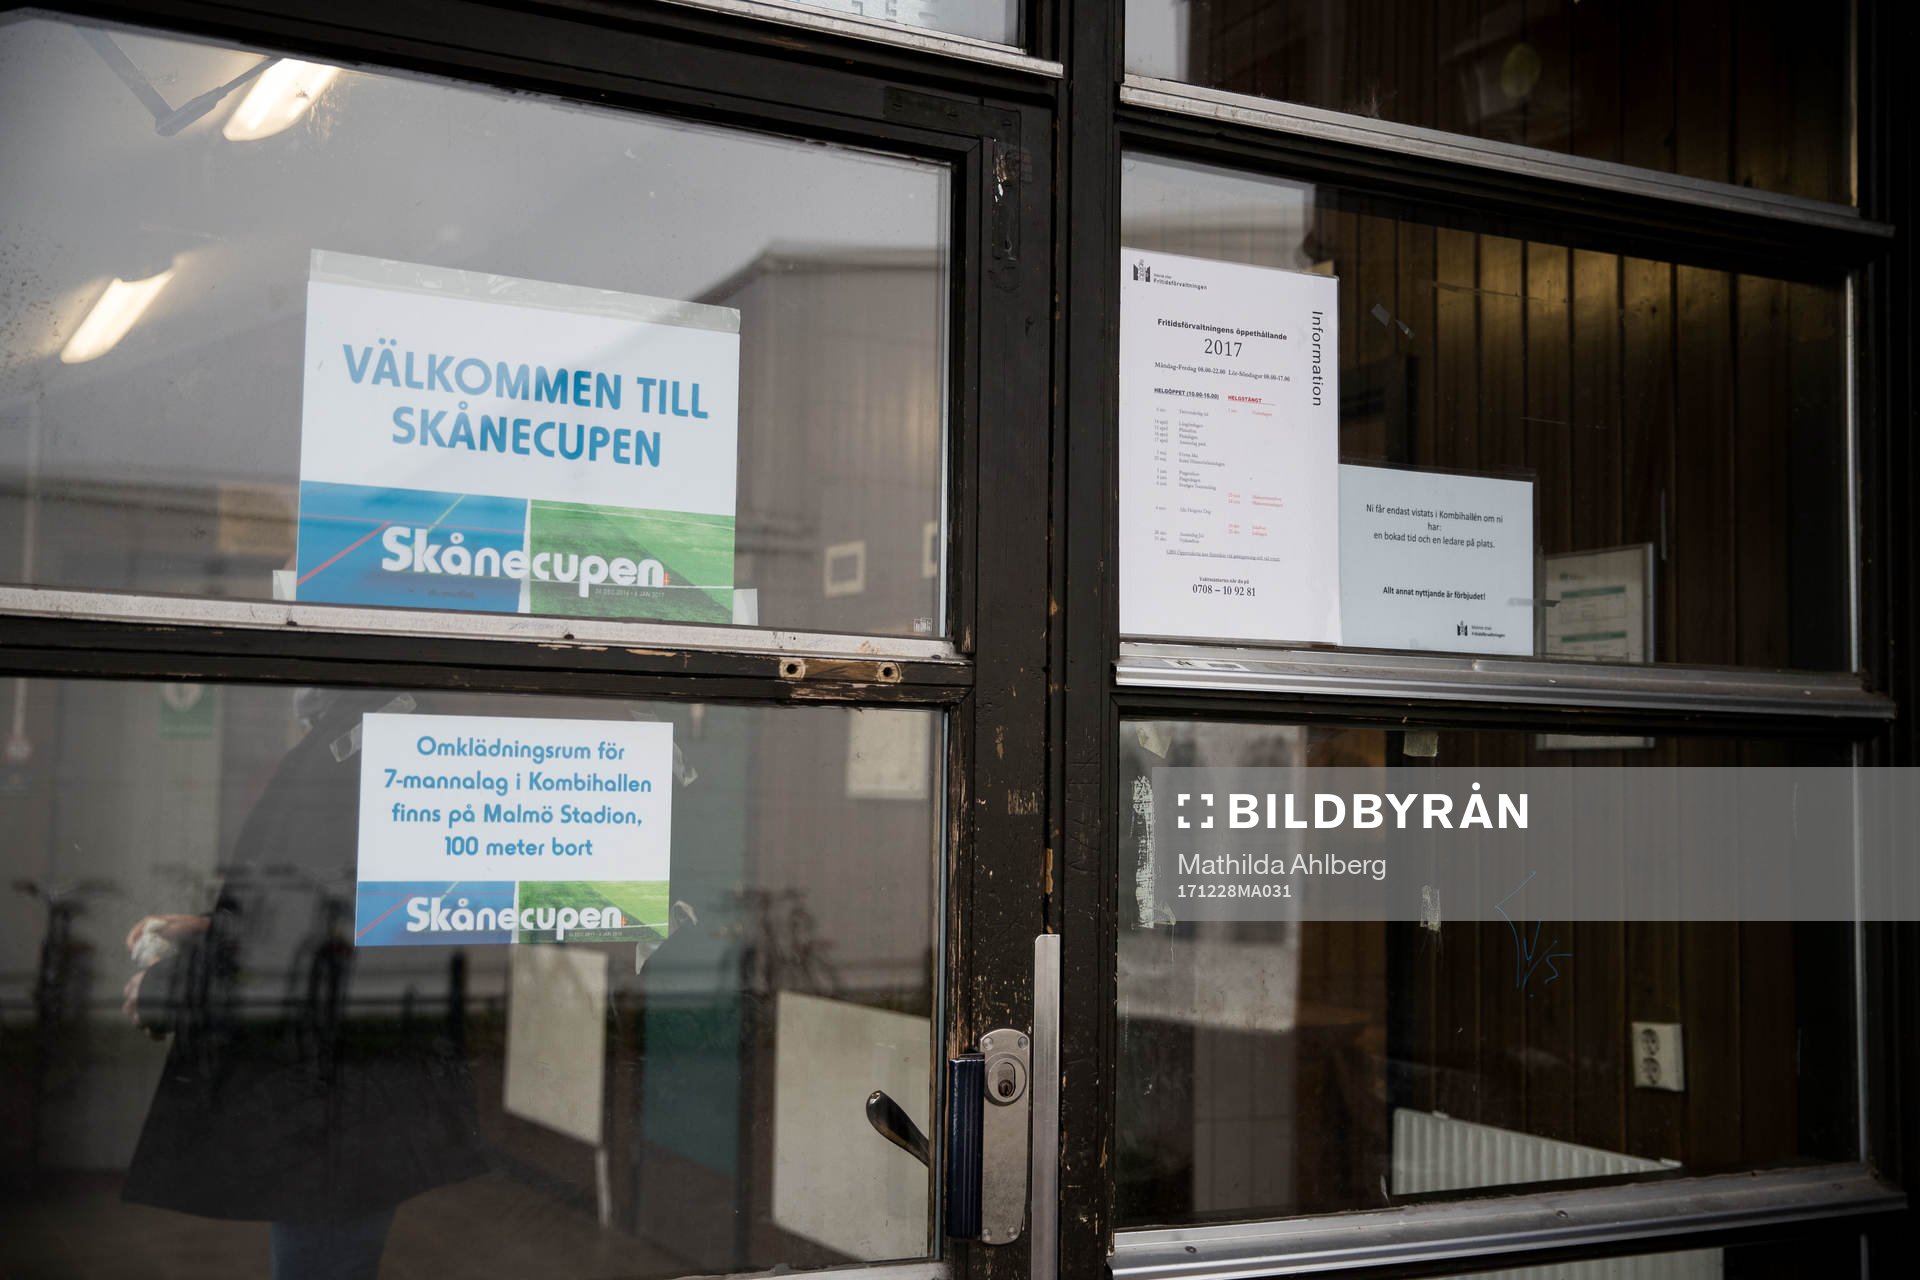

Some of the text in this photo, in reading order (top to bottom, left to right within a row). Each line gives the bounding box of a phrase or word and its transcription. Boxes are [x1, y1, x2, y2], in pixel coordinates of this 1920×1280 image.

[1157, 318, 1287, 341] Fritidsförvaltningens öppethållande
[1204, 338, 1242, 357] 2017
[1311, 311, 1324, 407] Information
[342, 337, 709, 420] VÄLKOMMEN TILL
[391, 401, 661, 468] SKÅNECUPEN
[1366, 503, 1375, 513] Ni
[1375, 504, 1385, 513] får
[1386, 506, 1410, 516] endast
[1411, 508, 1434, 518] vistats
[1483, 514, 1495, 523] om
[1496, 515, 1504, 524] ni
[1427, 522, 1442, 531] har:
[1384, 531, 1406, 542] bokad
[1407, 533, 1417, 542] tid
[1418, 534, 1431, 544] och
[1443, 536, 1465, 546] ledare
[1466, 536, 1475, 548] på
[1476, 538, 1495, 549] plats.
[381, 525, 664, 598] Skånecupen
[1192, 583, 1213, 594] 0708
[1223, 585, 1232, 595] 10
[1234, 586, 1245, 596] 92
[1246, 587, 1256, 597] 81
[1382, 586, 1486, 601] Allt annat nyttjande är förbjudet!
[416, 736, 625, 765] Omklädningsrum för
[384, 768, 652, 796] 7-mannalag i Kombihallen
[392, 803, 643, 828] finns på Malmö Stadion,
[444, 836, 593, 857] 100 meter bort
[406, 896, 622, 941] Skånecupen
